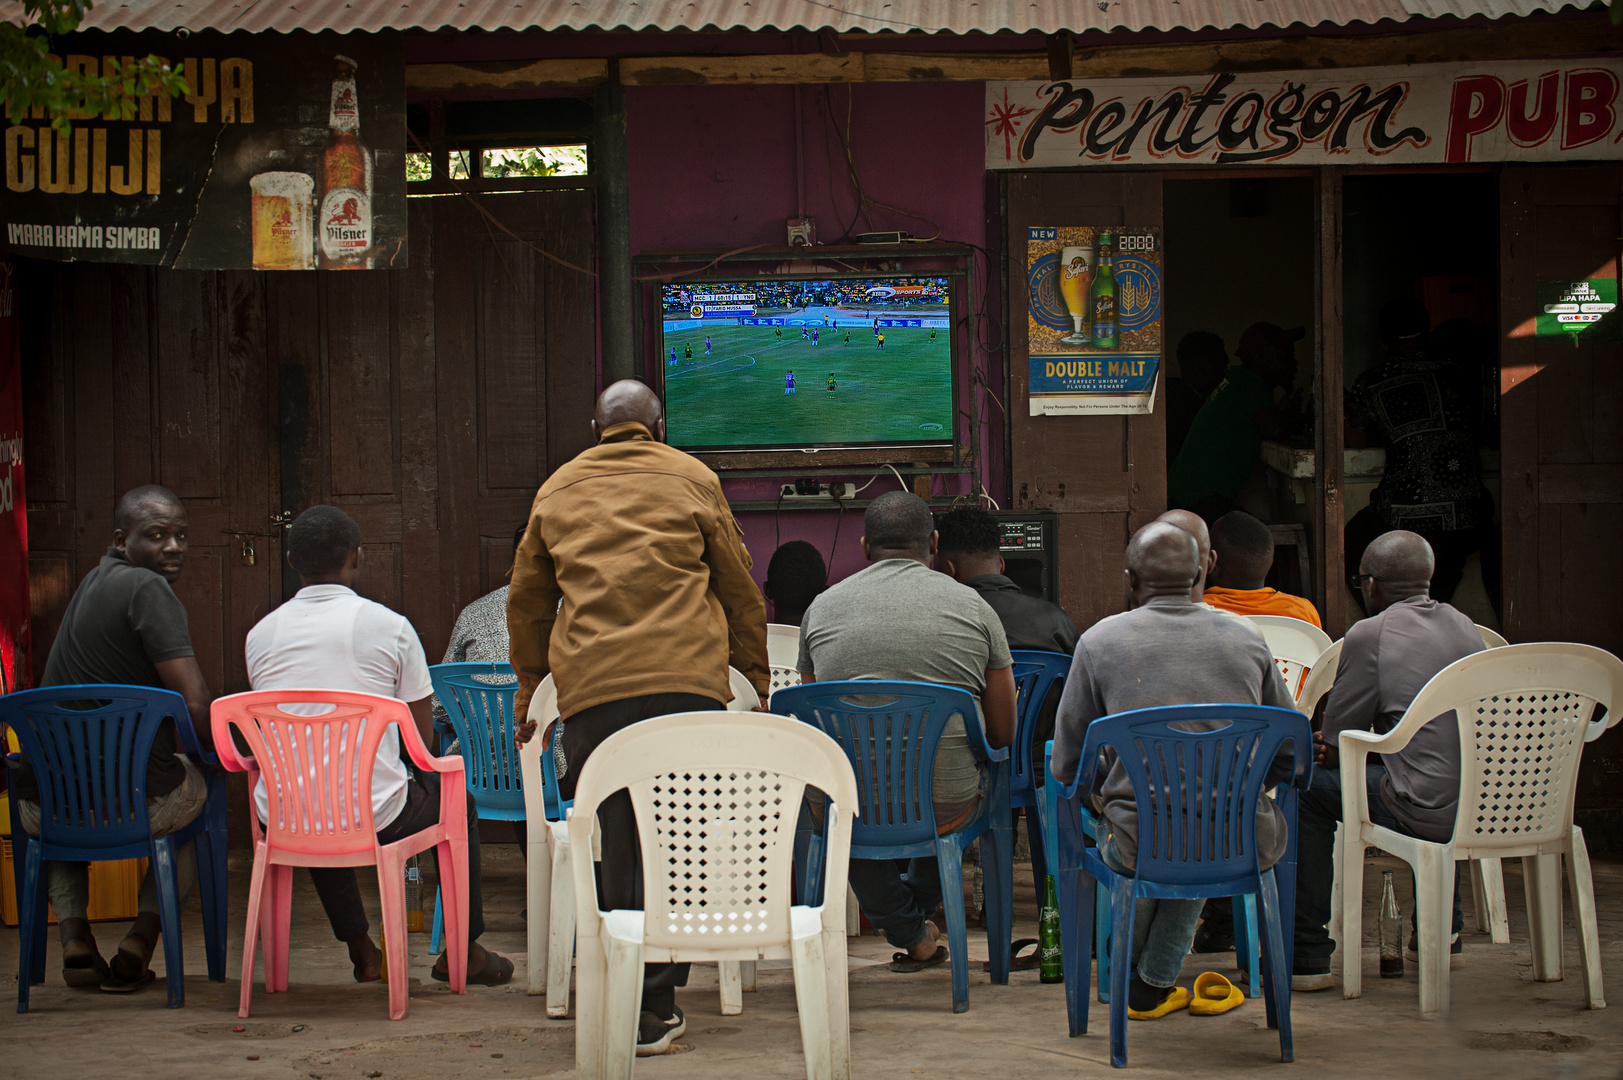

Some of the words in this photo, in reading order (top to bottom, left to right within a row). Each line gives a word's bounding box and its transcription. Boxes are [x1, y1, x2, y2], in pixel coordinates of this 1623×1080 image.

[184, 57, 254, 123] YA
[1020, 73, 1428, 162] Pentagon
[1446, 67, 1620, 163] PUB
[5, 125, 161, 195] GWIJI
[7, 222, 54, 247] IMARA
[55, 225, 103, 248] KAMA
[105, 226, 160, 250] SIMBA
[271, 226, 297, 236] Pilsner
[326, 226, 366, 241] Pilsner
[1032, 230, 1055, 238] NEW
[1065, 262, 1089, 280] Safari
[1113, 262, 1151, 279] CRYSTAL
[1045, 361, 1102, 378] DOUBLE
[1108, 360, 1146, 377] MALT
[1044, 946, 1061, 960] Sprite
